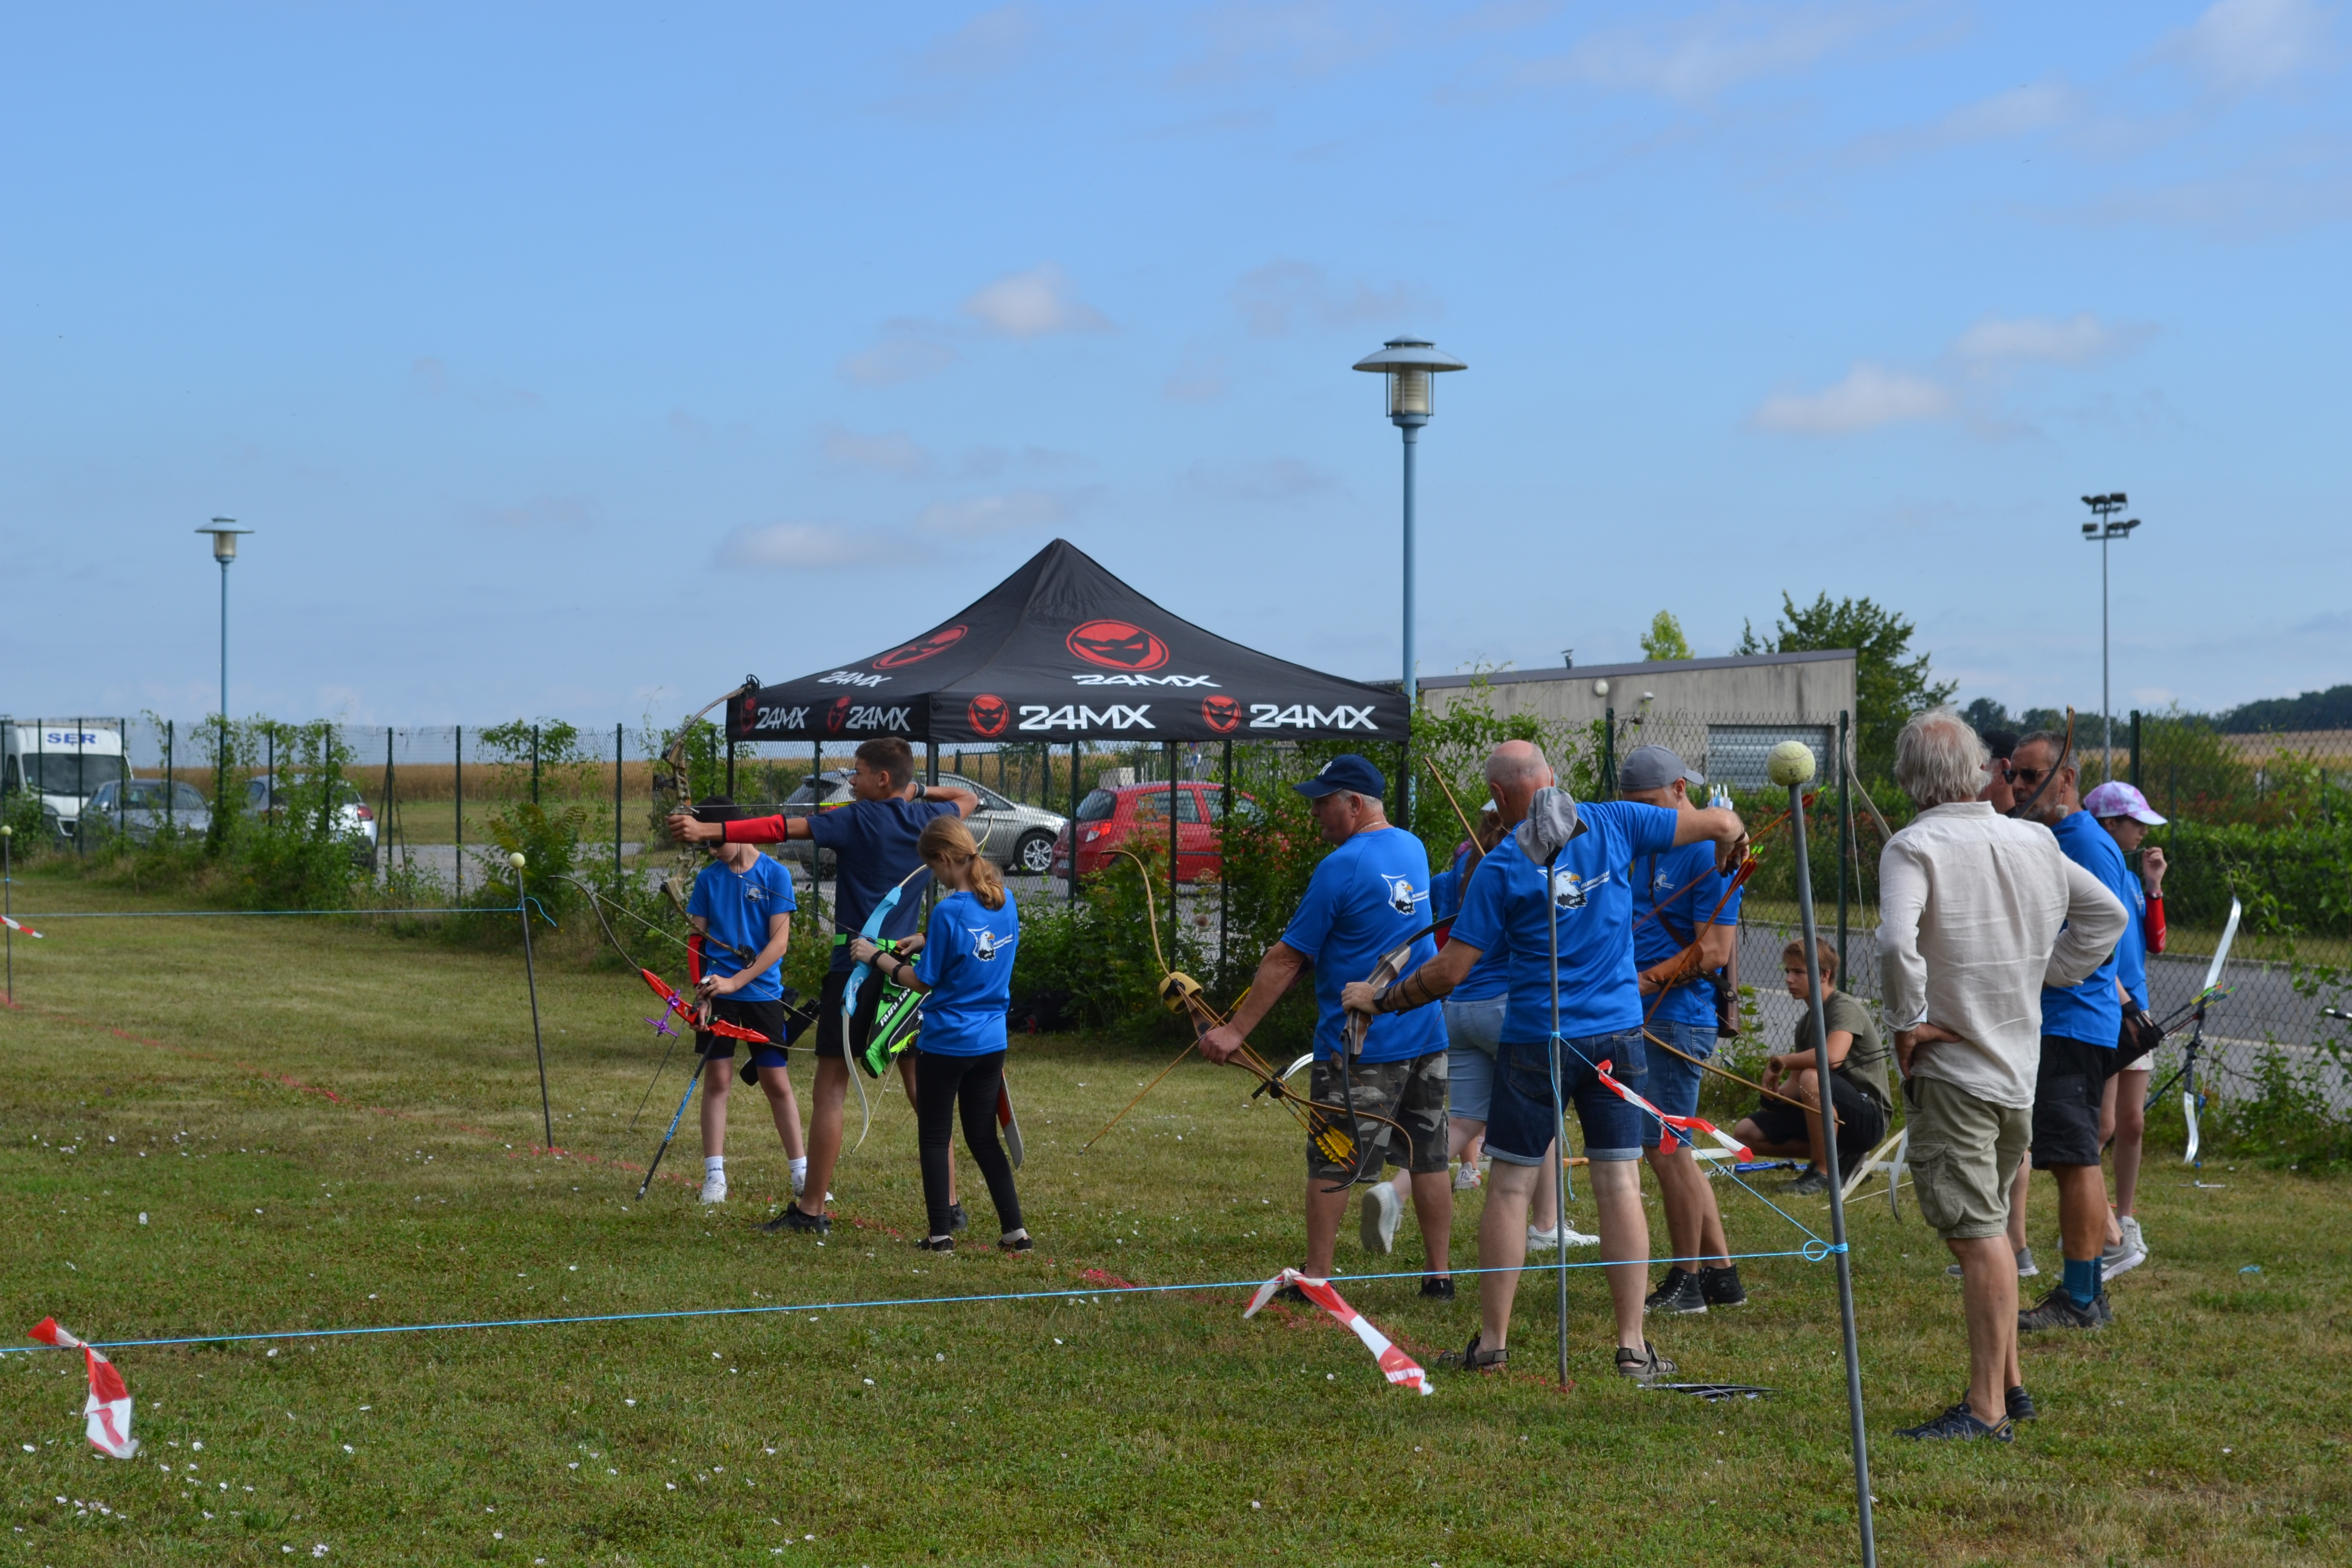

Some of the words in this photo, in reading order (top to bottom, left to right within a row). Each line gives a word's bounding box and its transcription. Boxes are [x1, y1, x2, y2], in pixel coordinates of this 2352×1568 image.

[818, 671, 892, 687] 24MX
[1072, 674, 1222, 688] 24MX
[755, 707, 810, 729] 24MX
[845, 706, 911, 731] 24MX
[1019, 704, 1156, 730] 24MX
[1250, 704, 1379, 730] 24MX
[46, 733, 96, 744] SER
[880, 988, 911, 1027] AVALON
